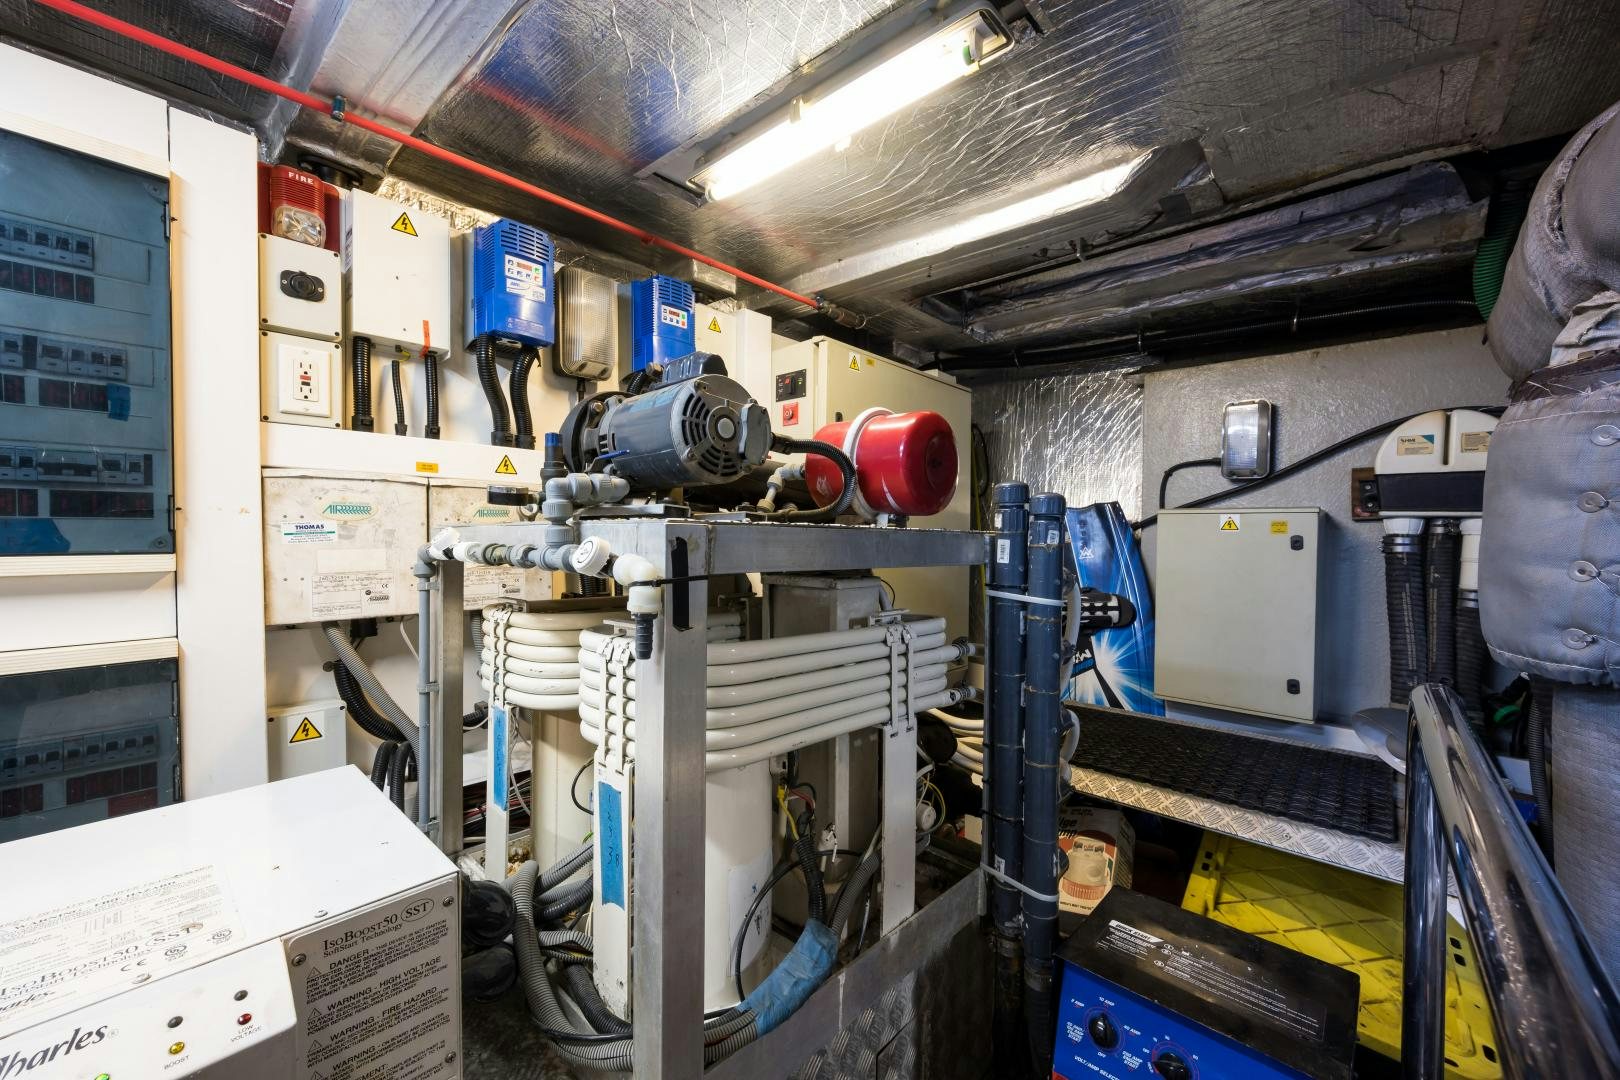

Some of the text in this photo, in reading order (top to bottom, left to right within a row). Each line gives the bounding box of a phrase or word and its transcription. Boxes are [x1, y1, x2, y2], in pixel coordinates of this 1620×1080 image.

[288, 171, 314, 185] FIRE
[406, 901, 429, 919] SST
[324, 922, 402, 959] SoftStart Technology
[330, 949, 369, 970] DANGER
[327, 956, 441, 1012] WARNING HIGH VOLTAGE
[330, 987, 437, 1042] WARNING FIRE HAZARD
[230, 1026, 262, 1043] VOLTAGE
[237, 1023, 254, 1034] LOW
[1130, 1027, 1141, 1036] AMP
[163, 1055, 190, 1070] BOOST
[333, 1045, 376, 1071] WARNING
[1074, 1055, 1100, 1072] VOLT/AMP
[1131, 1054, 1143, 1063] AMP
